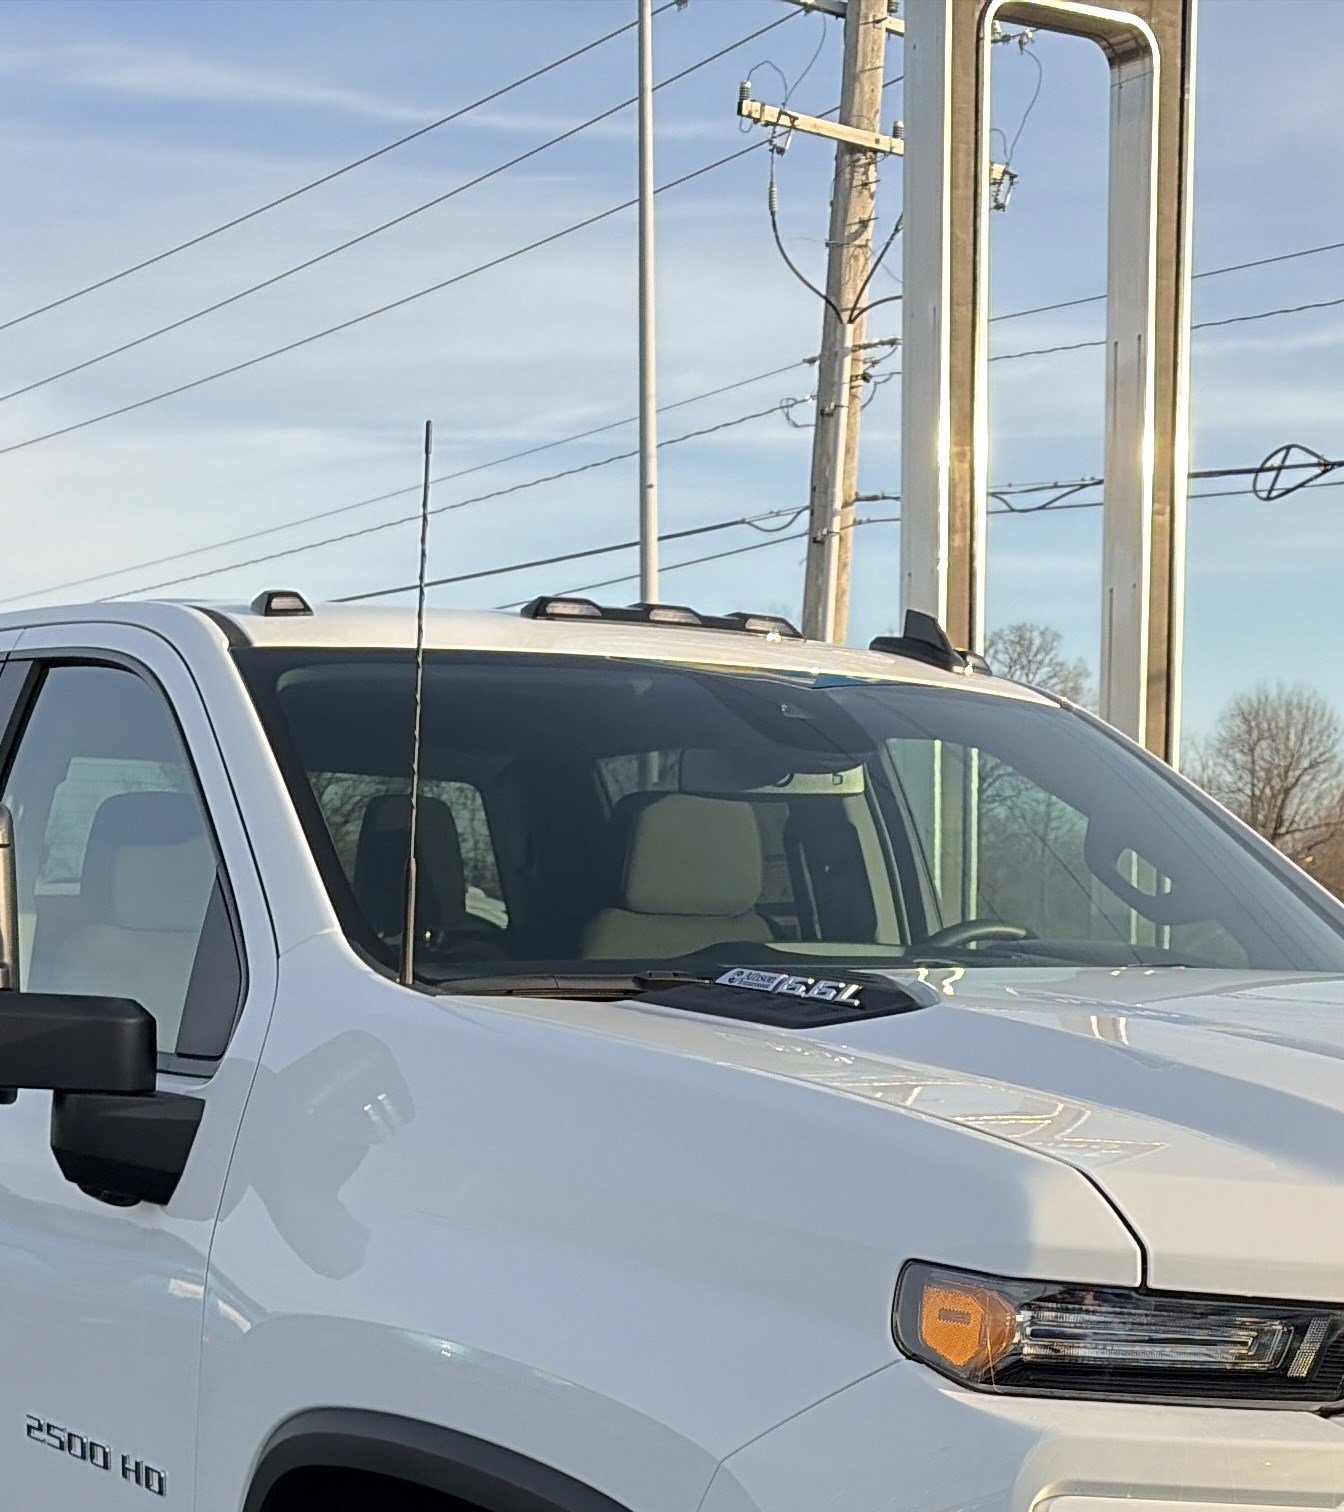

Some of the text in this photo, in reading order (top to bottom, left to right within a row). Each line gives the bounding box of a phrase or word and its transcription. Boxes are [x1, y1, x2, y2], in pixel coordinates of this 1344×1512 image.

[776, 976, 862, 1006] 6.6L
[26, 1413, 168, 1497] 2500 HD
